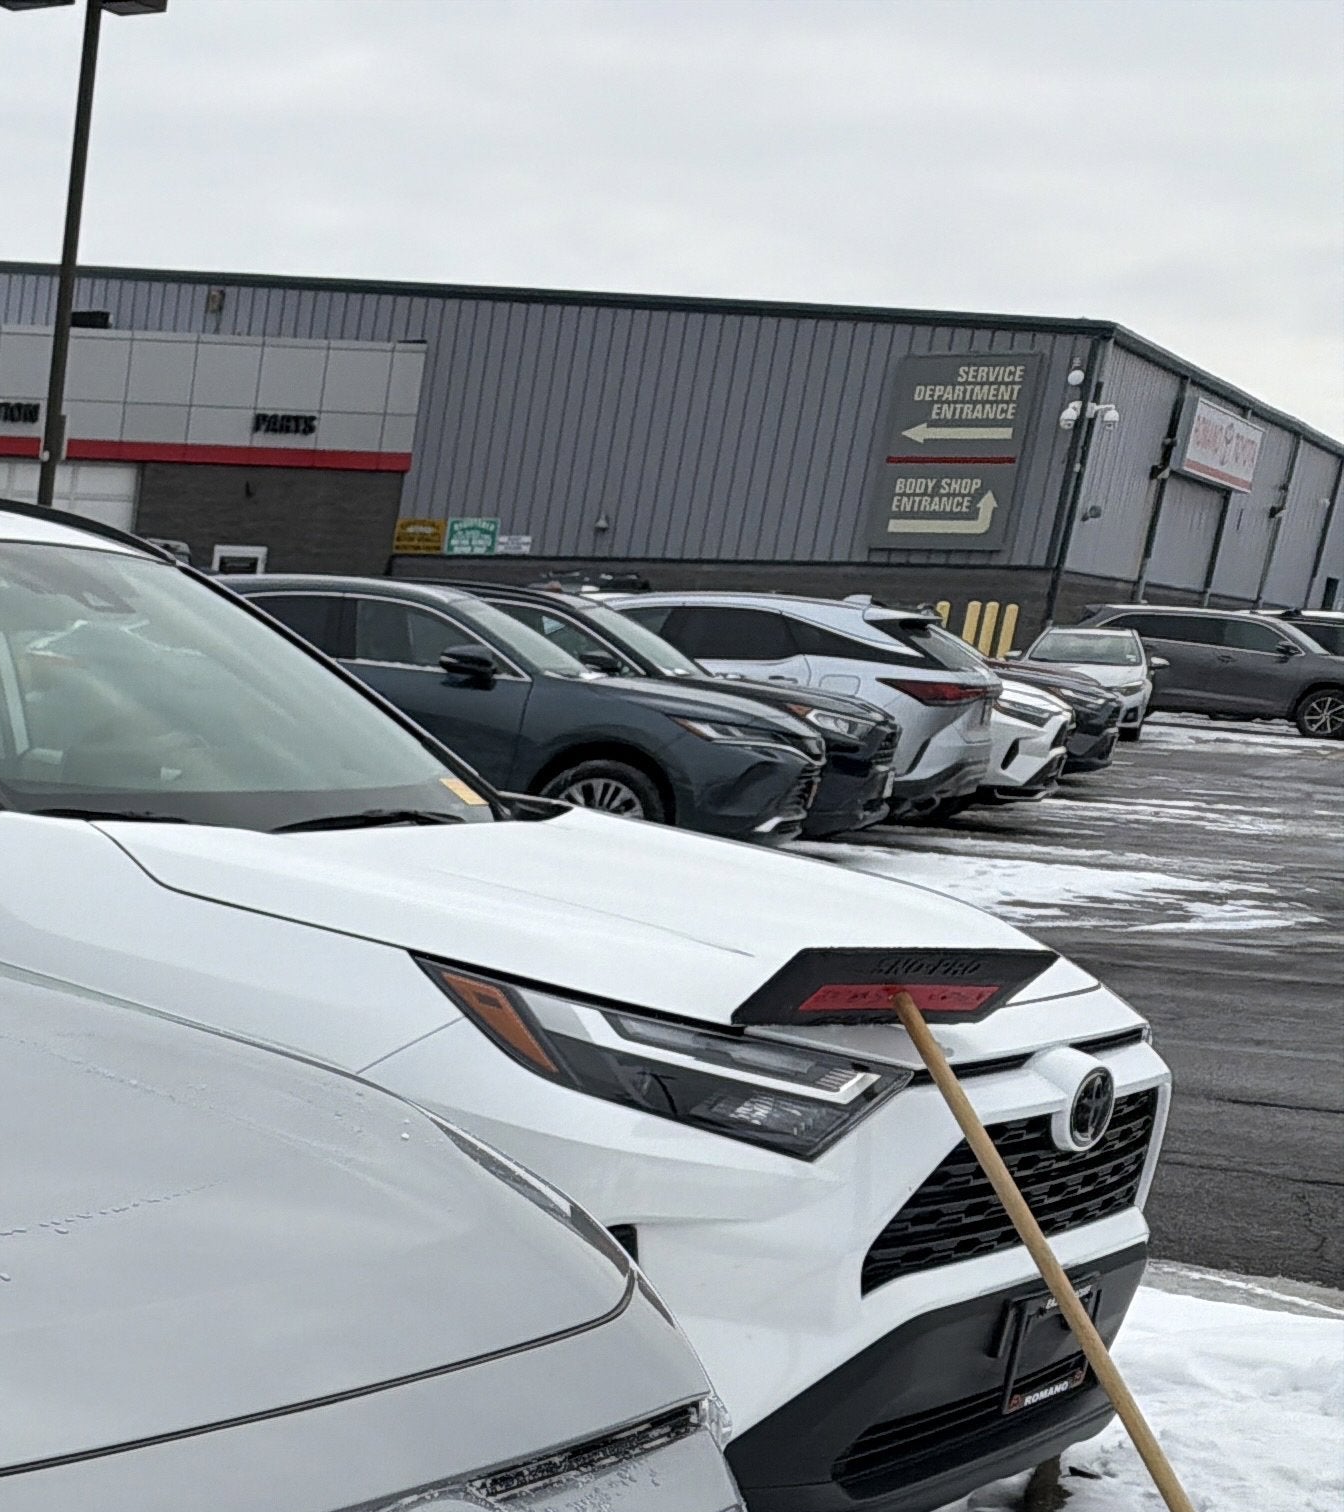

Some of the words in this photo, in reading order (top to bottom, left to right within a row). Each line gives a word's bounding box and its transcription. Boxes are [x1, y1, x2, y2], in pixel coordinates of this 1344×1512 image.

[957, 365, 1026, 382] SERVICE
[914, 384, 1022, 401] DEPARTMENT
[931, 403, 1017, 419] ENTRANCE
[253, 413, 318, 436] PARTS
[895, 478, 937, 494] BODY
[940, 478, 982, 494] SHOP
[891, 496, 972, 513] ENTRANCE
[1024, 1380, 1070, 1406] ROMANO
